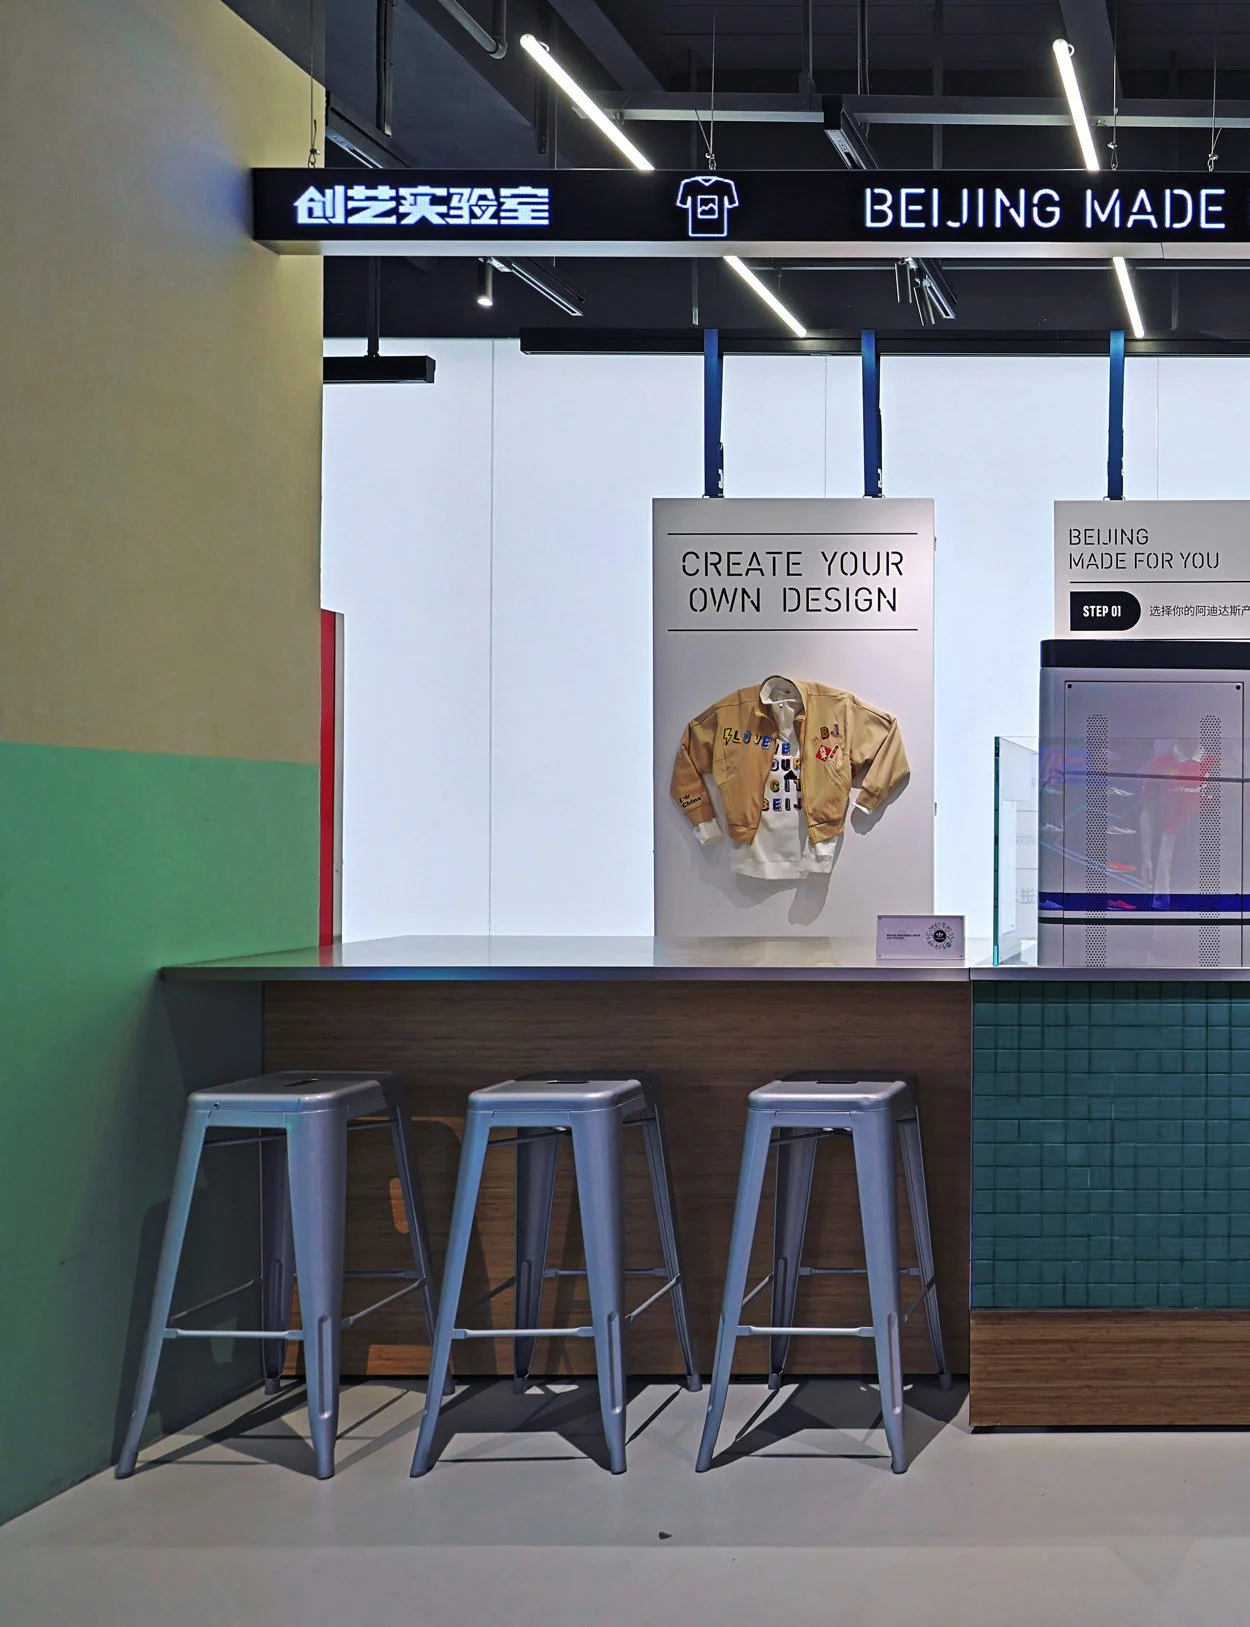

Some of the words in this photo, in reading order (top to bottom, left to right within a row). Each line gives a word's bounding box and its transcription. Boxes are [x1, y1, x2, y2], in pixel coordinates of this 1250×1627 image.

[293, 185, 549, 226] 创艺实验室
[865, 187, 1061, 229] BEIJING
[1086, 188, 1226, 229] MADE
[1069, 528, 1149, 546] BEIJING
[682, 551, 803, 577] CREATE
[821, 551, 904, 577] YOUR
[1069, 552, 1127, 570] MADE
[1134, 552, 1174, 570] FOR
[1180, 552, 1219, 570] YOU
[689, 587, 761, 613] OWN
[782, 587, 897, 613] DESIGN
[1083, 605, 1109, 618] STEP
[1112, 605, 1122, 618] 01
[732, 730, 771, 750] LOVE
[681, 795, 702, 808] China
